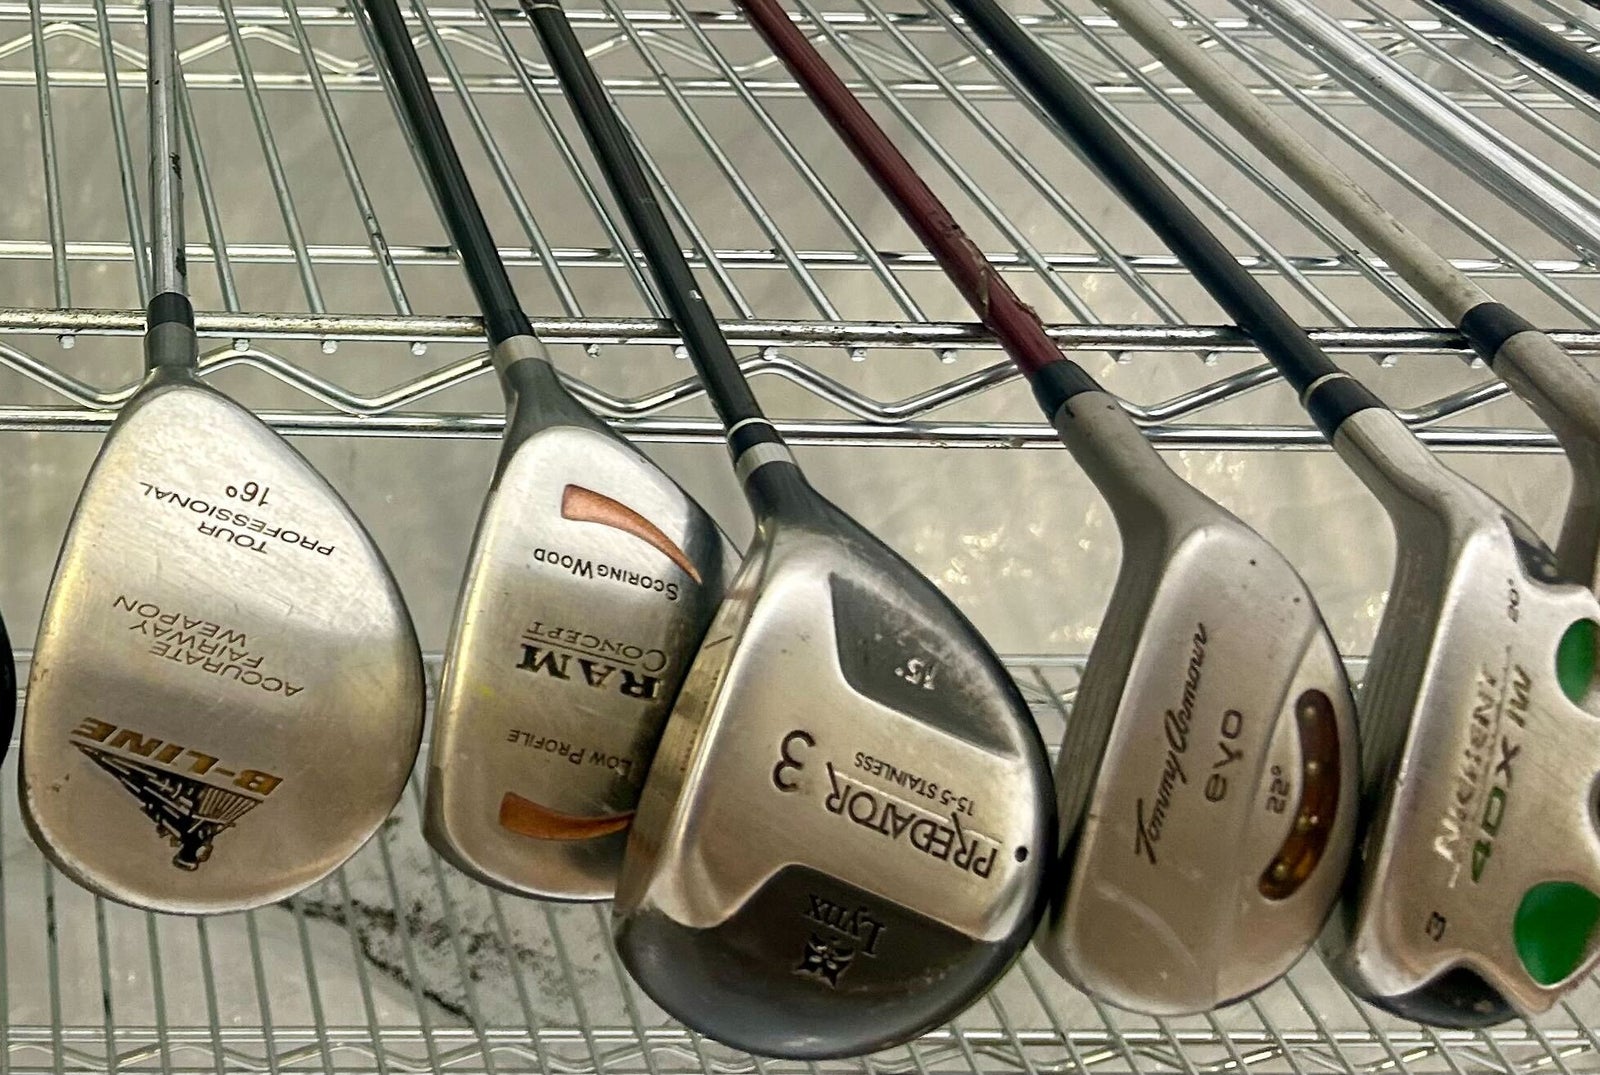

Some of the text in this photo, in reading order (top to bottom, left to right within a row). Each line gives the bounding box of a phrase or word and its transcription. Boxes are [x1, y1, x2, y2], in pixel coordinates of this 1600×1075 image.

[138, 482, 336, 556] PROFESSIONAL
[197, 521, 269, 555] TOUR
[113, 595, 246, 648] WEAPON
[129, 621, 265, 668] FAIRWAY
[148, 642, 304, 698] ACCURATE
[517, 643, 665, 700] RAM
[69, 717, 284, 799] B-LINE
[772, 730, 816, 793] 3
[1135, 622, 1208, 864] Tommy Armour
[854, 751, 976, 816] 15-5 STAINLESS
[824, 762, 998, 880] PREDATOR
